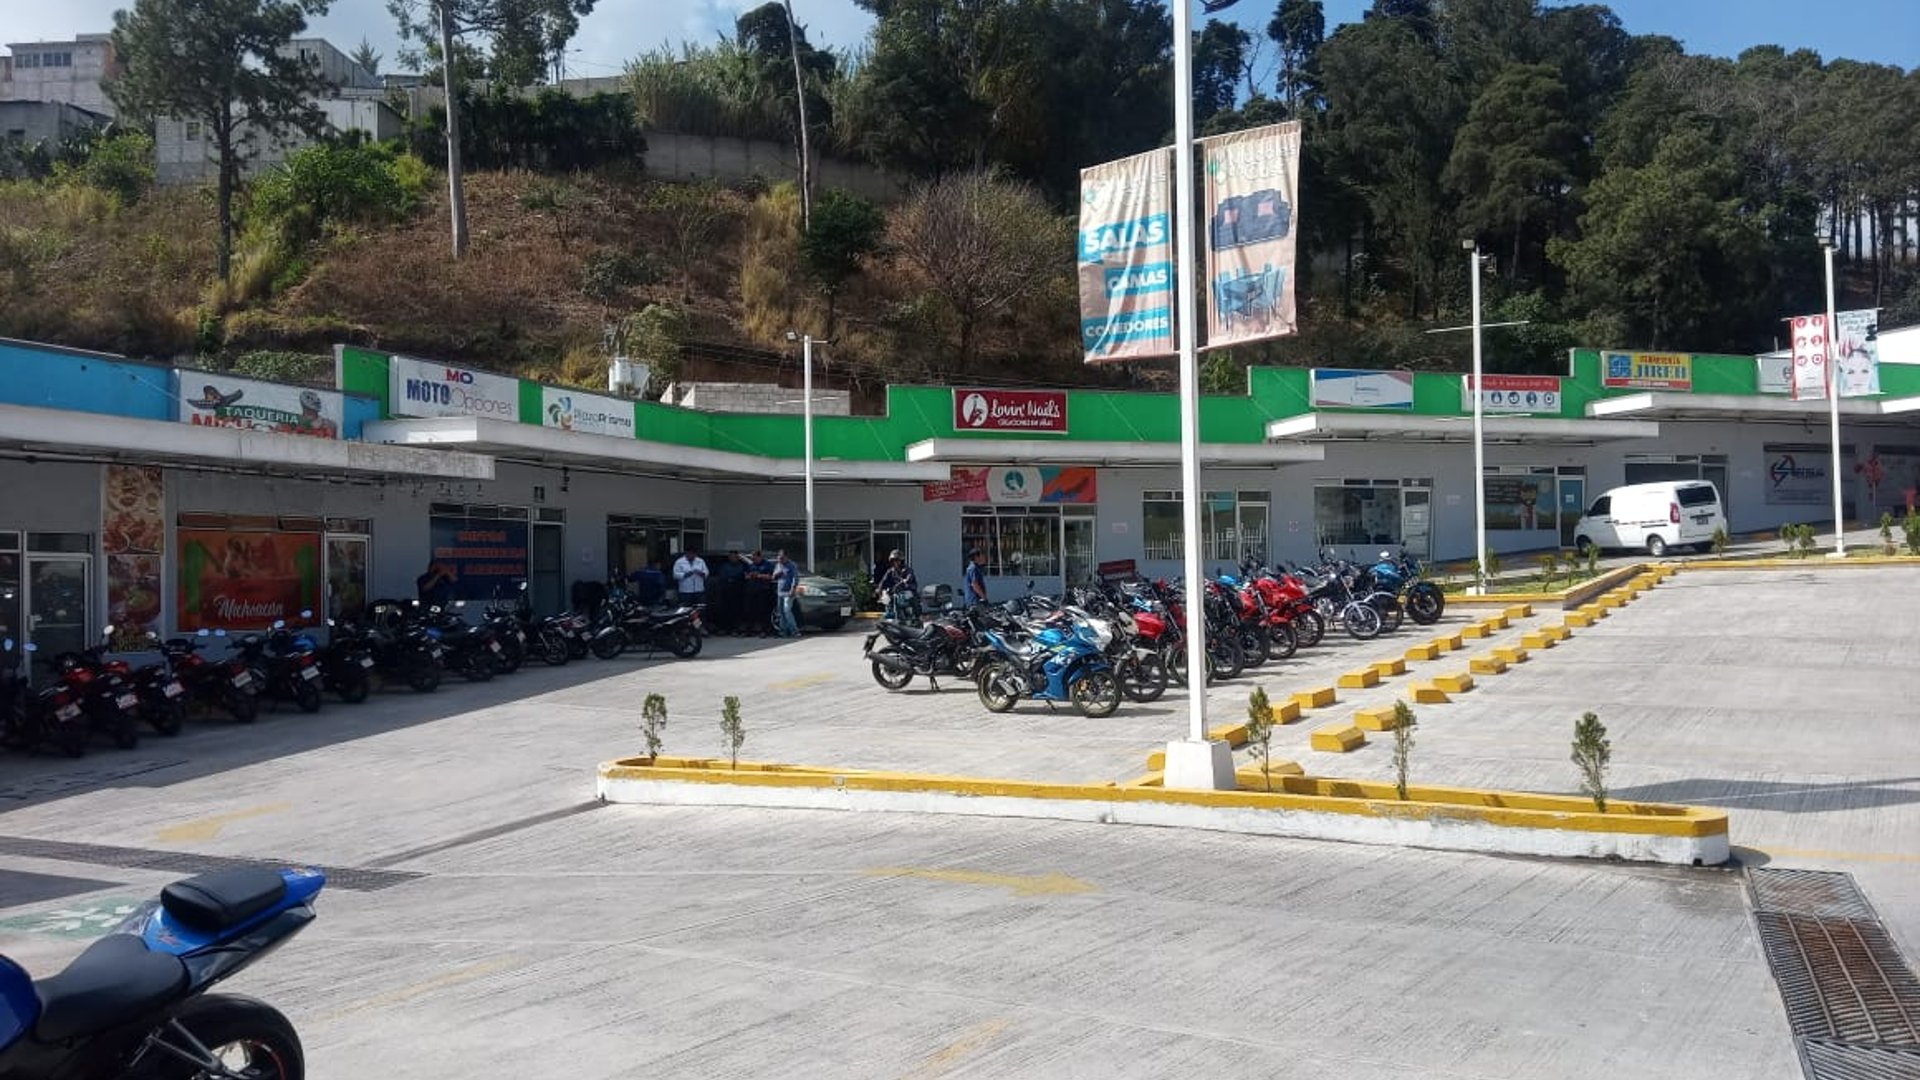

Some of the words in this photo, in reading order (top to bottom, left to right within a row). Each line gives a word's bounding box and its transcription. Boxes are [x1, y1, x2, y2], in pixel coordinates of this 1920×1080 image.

[1085, 220, 1165, 253] SALAS
[445, 368, 474, 385] MO
[406, 379, 450, 405] MOTO
[225, 406, 299, 425] TAQUERIA
[991, 399, 1026, 418] Lovin'
[1027, 399, 1061, 418] Nails
